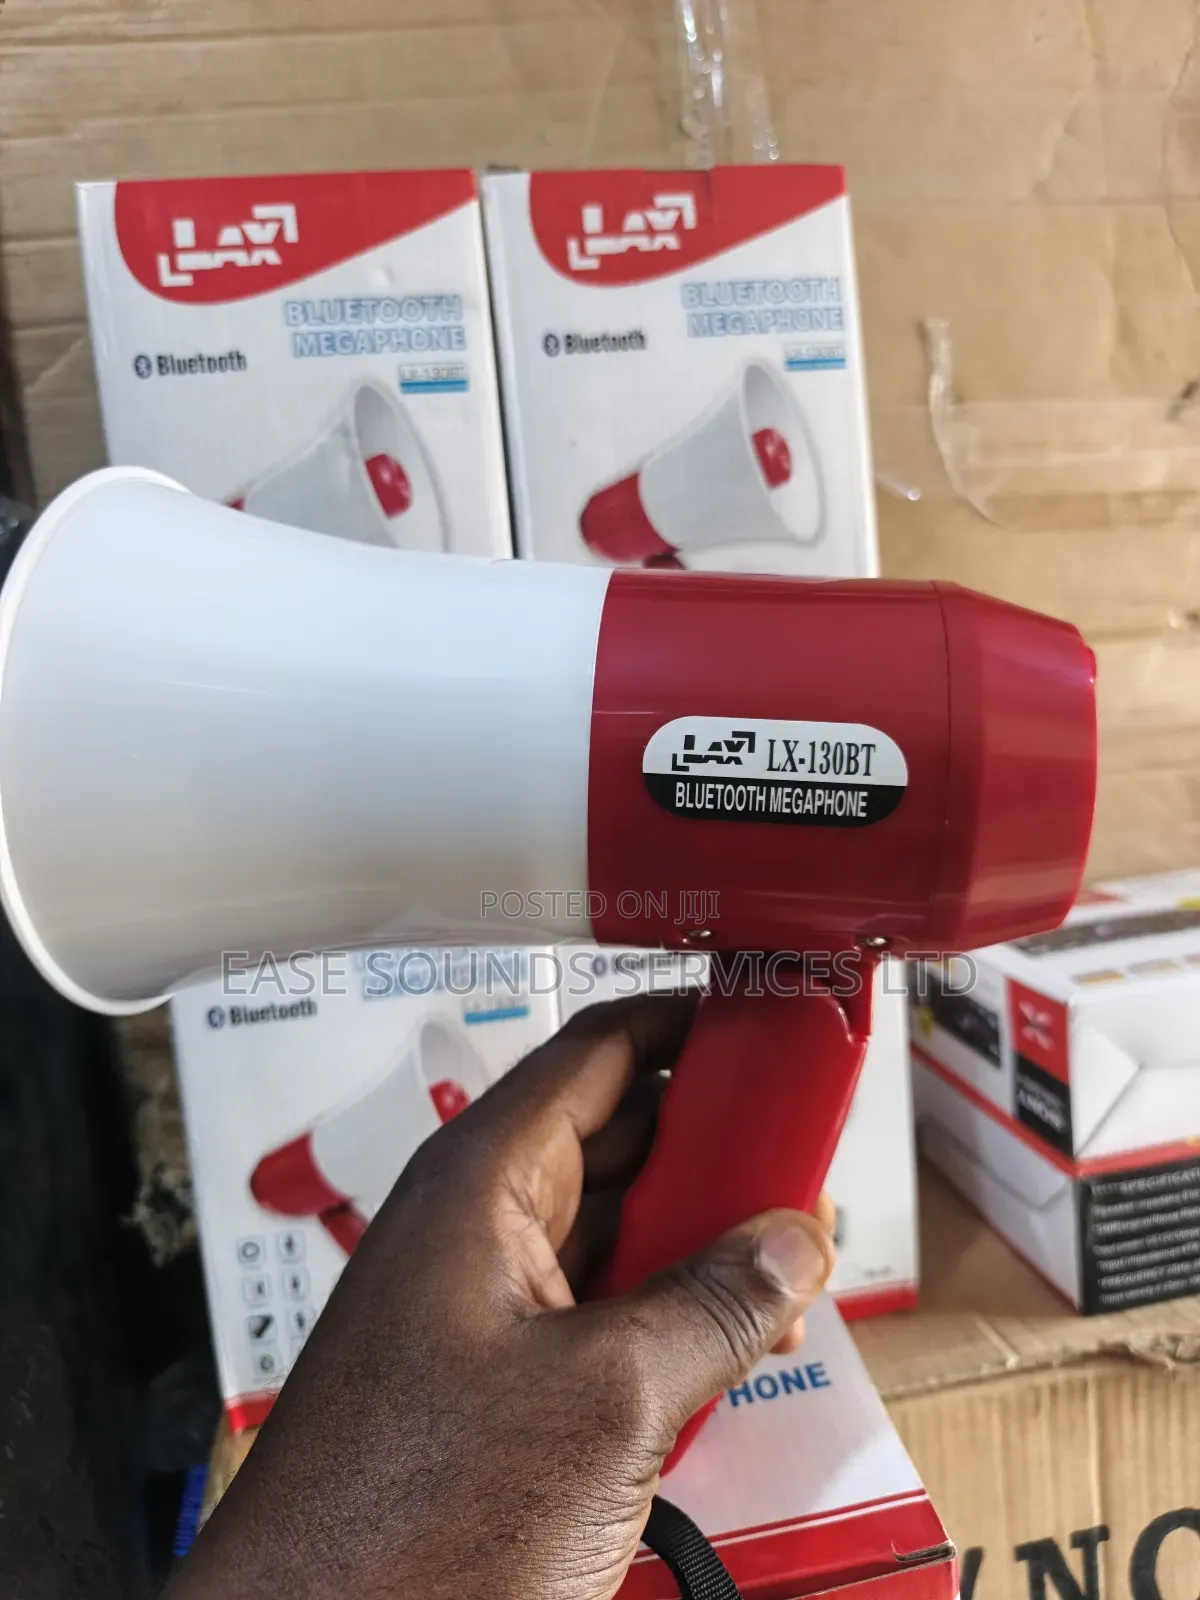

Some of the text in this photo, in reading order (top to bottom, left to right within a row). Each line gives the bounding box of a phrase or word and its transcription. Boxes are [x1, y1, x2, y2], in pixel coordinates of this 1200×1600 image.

[681, 276, 841, 308] BLUETOOTH
[285, 295, 464, 326] BLUETOOTH
[686, 306, 845, 337] MEGAPHONE
[292, 326, 467, 358] MEGAPHONE
[563, 328, 647, 355] Bluetooth
[157, 349, 248, 376] Bluetooth
[766, 739, 876, 777] LX-130BT
[675, 781, 868, 818] BLUETOOTH MEGAPHONE
[229, 998, 319, 1026] Bluetooth
[713, 1360, 831, 1408] HONE
